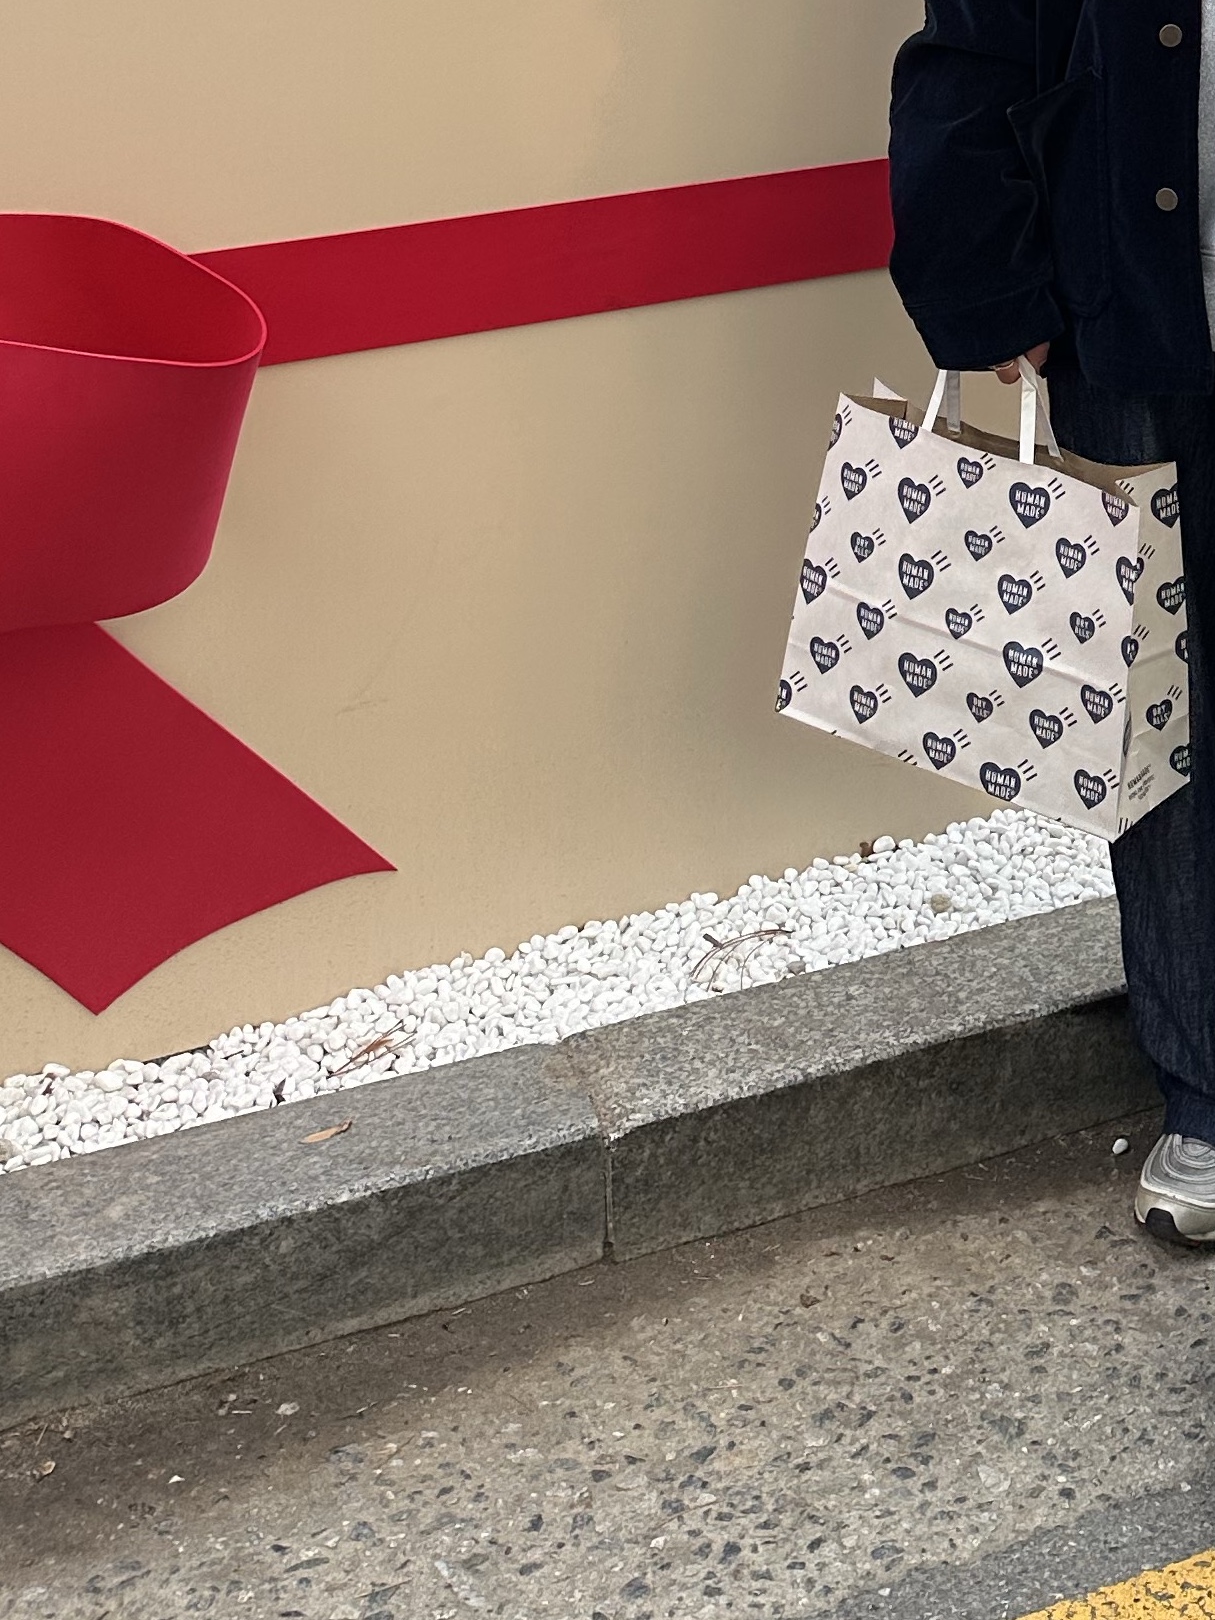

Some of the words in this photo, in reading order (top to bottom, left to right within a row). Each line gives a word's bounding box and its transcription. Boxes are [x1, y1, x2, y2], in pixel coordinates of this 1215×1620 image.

[843, 468, 863, 484] HUMAN
[960, 462, 980, 475] HUMAN
[903, 485, 927, 503] HUMAN
[1015, 490, 1046, 508] HUMAN
[1156, 490, 1178, 510] HUMA
[1059, 544, 1082, 560] HUMAN
[803, 565, 824, 584] HUMAN
[902, 560, 928, 580] HUMAN
[1002, 580, 1028, 598] HUMAN
[860, 606, 880, 623] HUMAN
[814, 643, 836, 659] HUMAN
[1008, 648, 1038, 668] HUMAN
[903, 659, 932, 678] HUMAN
[853, 691, 874, 708] HUMAN
[1085, 690, 1109, 708] HUMAN
[1034, 716, 1059, 732] HUMAN
[926, 737, 952, 754] HUMAN
[985, 768, 1016, 789] HUMAN
[1078, 774, 1103, 792] HUMAN
